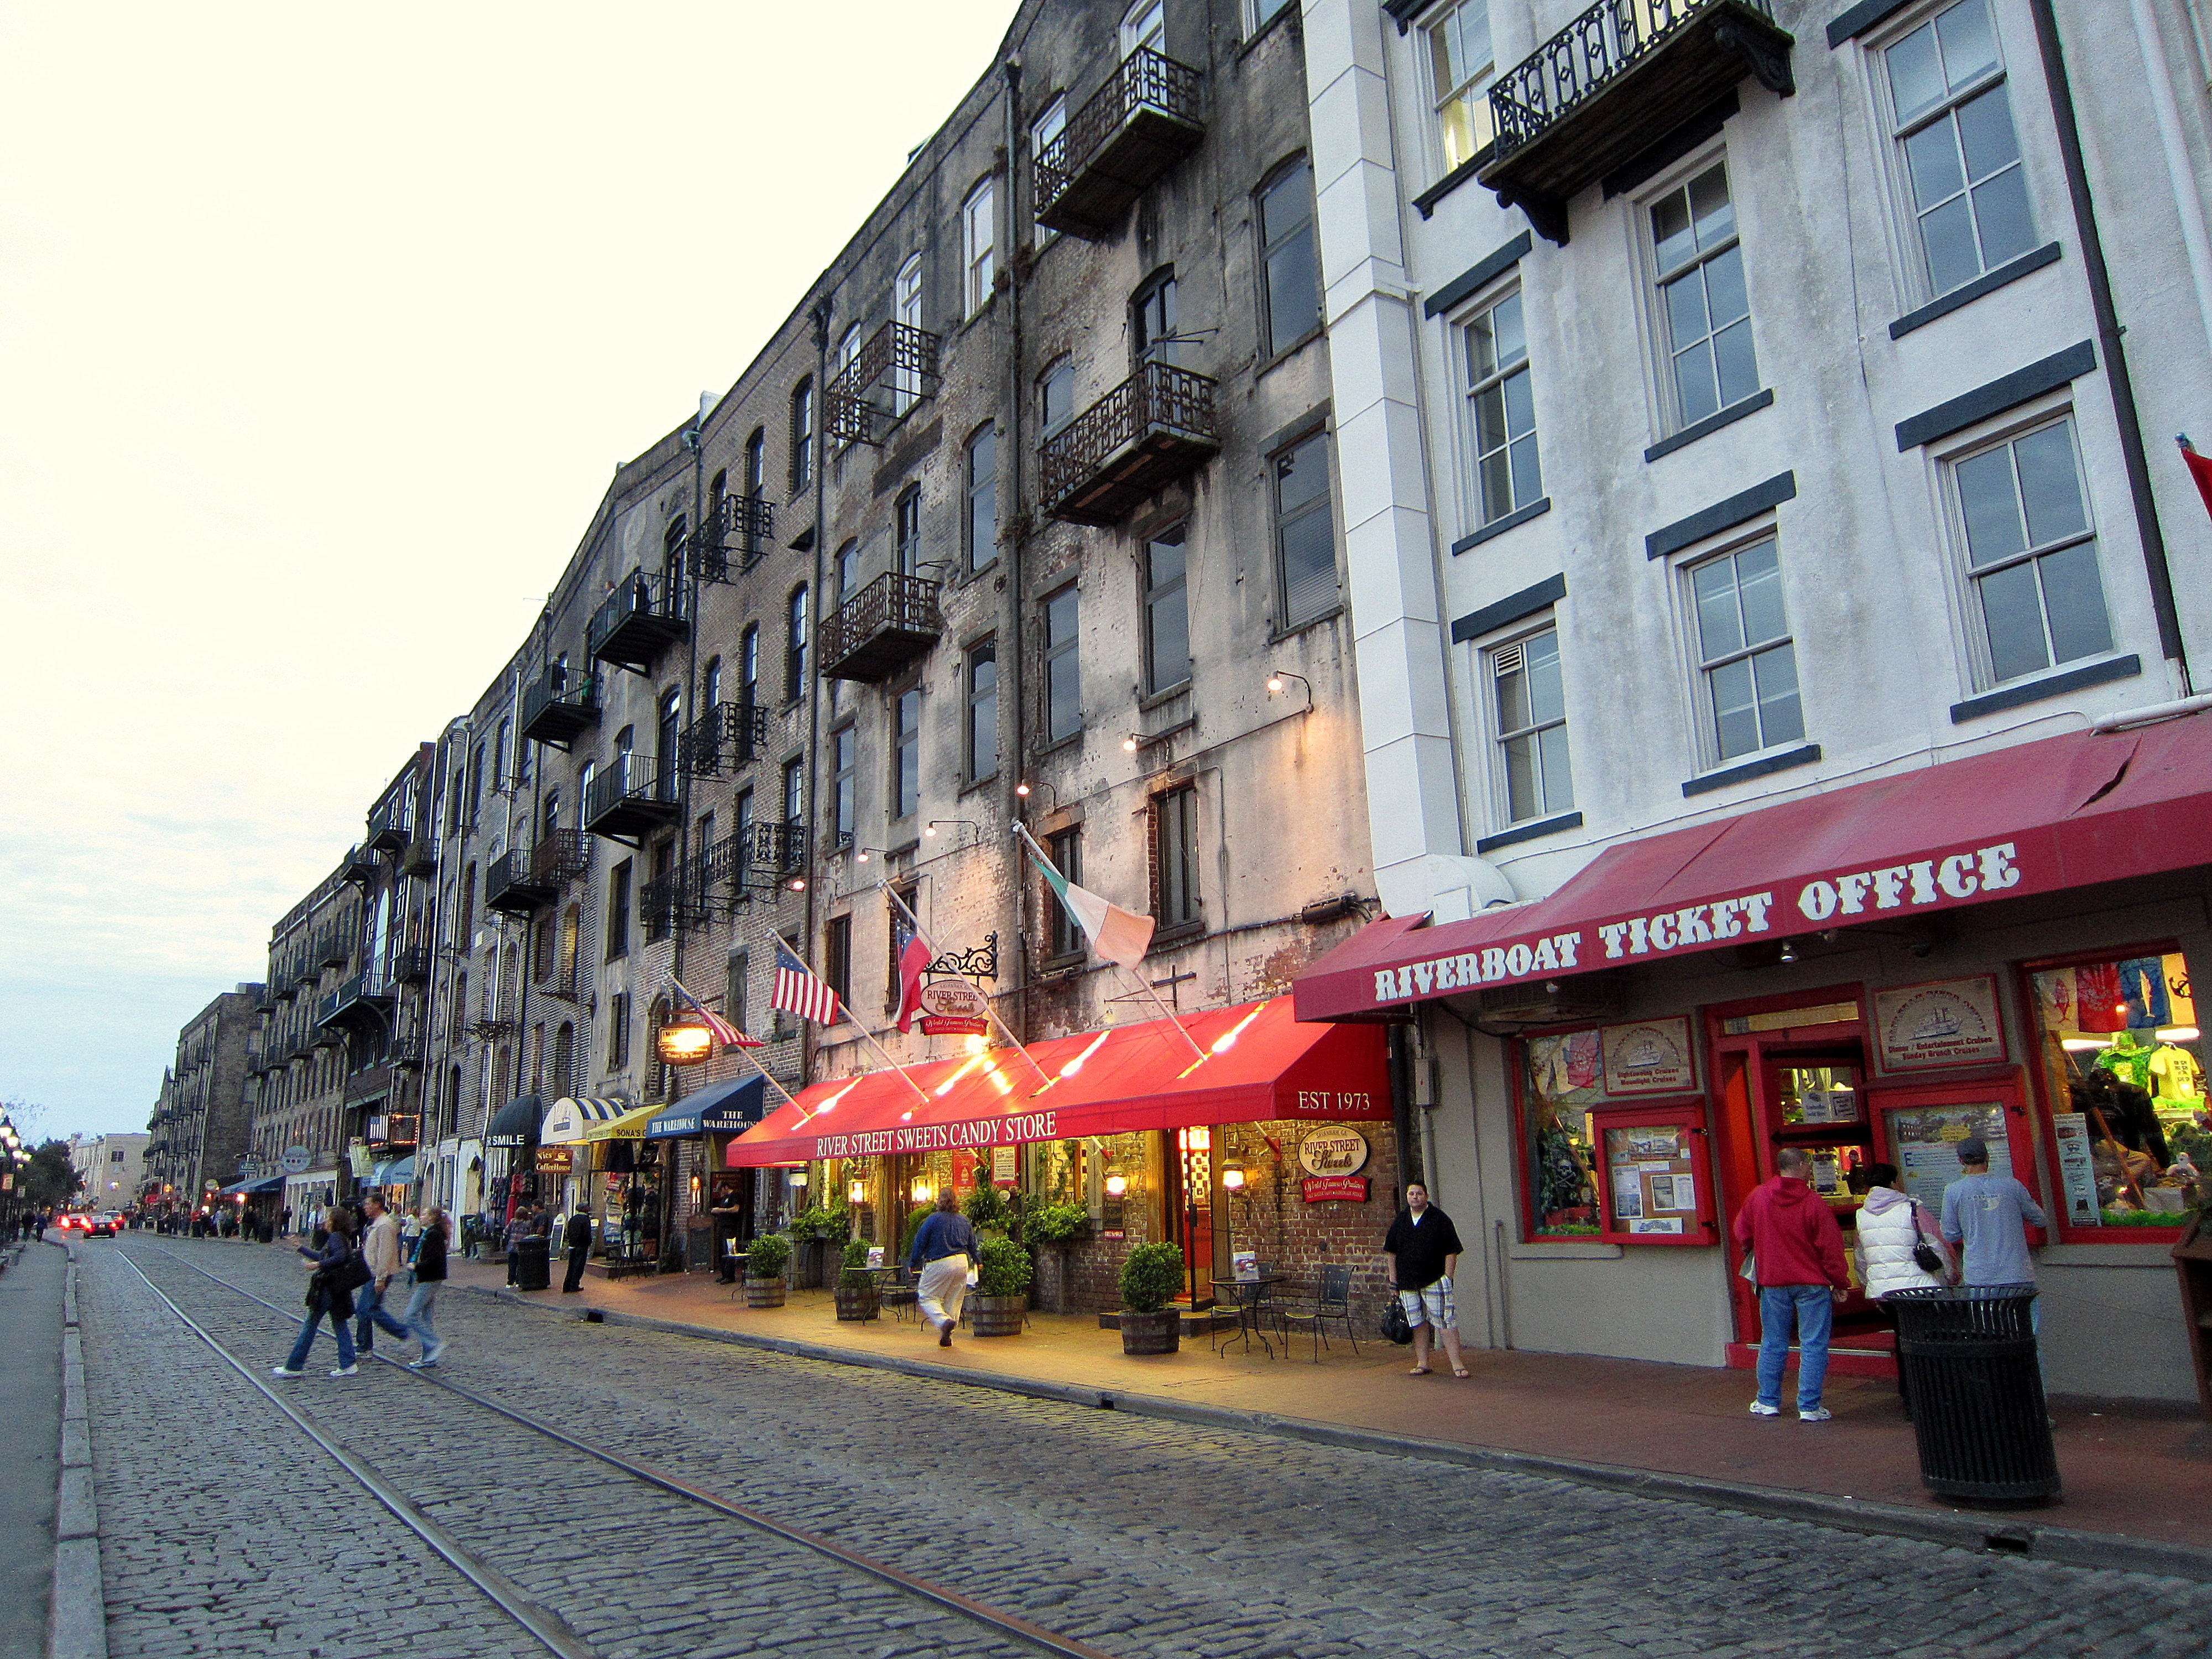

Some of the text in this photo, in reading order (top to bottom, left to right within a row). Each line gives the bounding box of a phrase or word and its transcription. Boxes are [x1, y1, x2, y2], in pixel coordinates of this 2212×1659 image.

[1374, 842, 2020, 1001] RIVERBOAT TICKET OFFICE
[927, 990, 983, 1001] RIVER STREE
[1916, 1040, 1964, 1050] Entertainment
[1966, 1036, 1992, 1045] Cruises
[1298, 1091, 1370, 1110] EST 1973
[722, 1110, 743, 1119] THE
[651, 1121, 662, 1134] THE
[664, 1118, 695, 1131] WAREHOUSE
[703, 1119, 760, 1129] WAREHOUS
[817, 1111, 1057, 1157] RIVER STREET SWEETS CANDY STORE
[1305, 1139, 1360, 1155] RIVER STREET
[1311, 1149, 1353, 1170] Sweets
[1305, 1181, 1322, 1192] World
[1322, 1178, 1342, 1190] Famous
